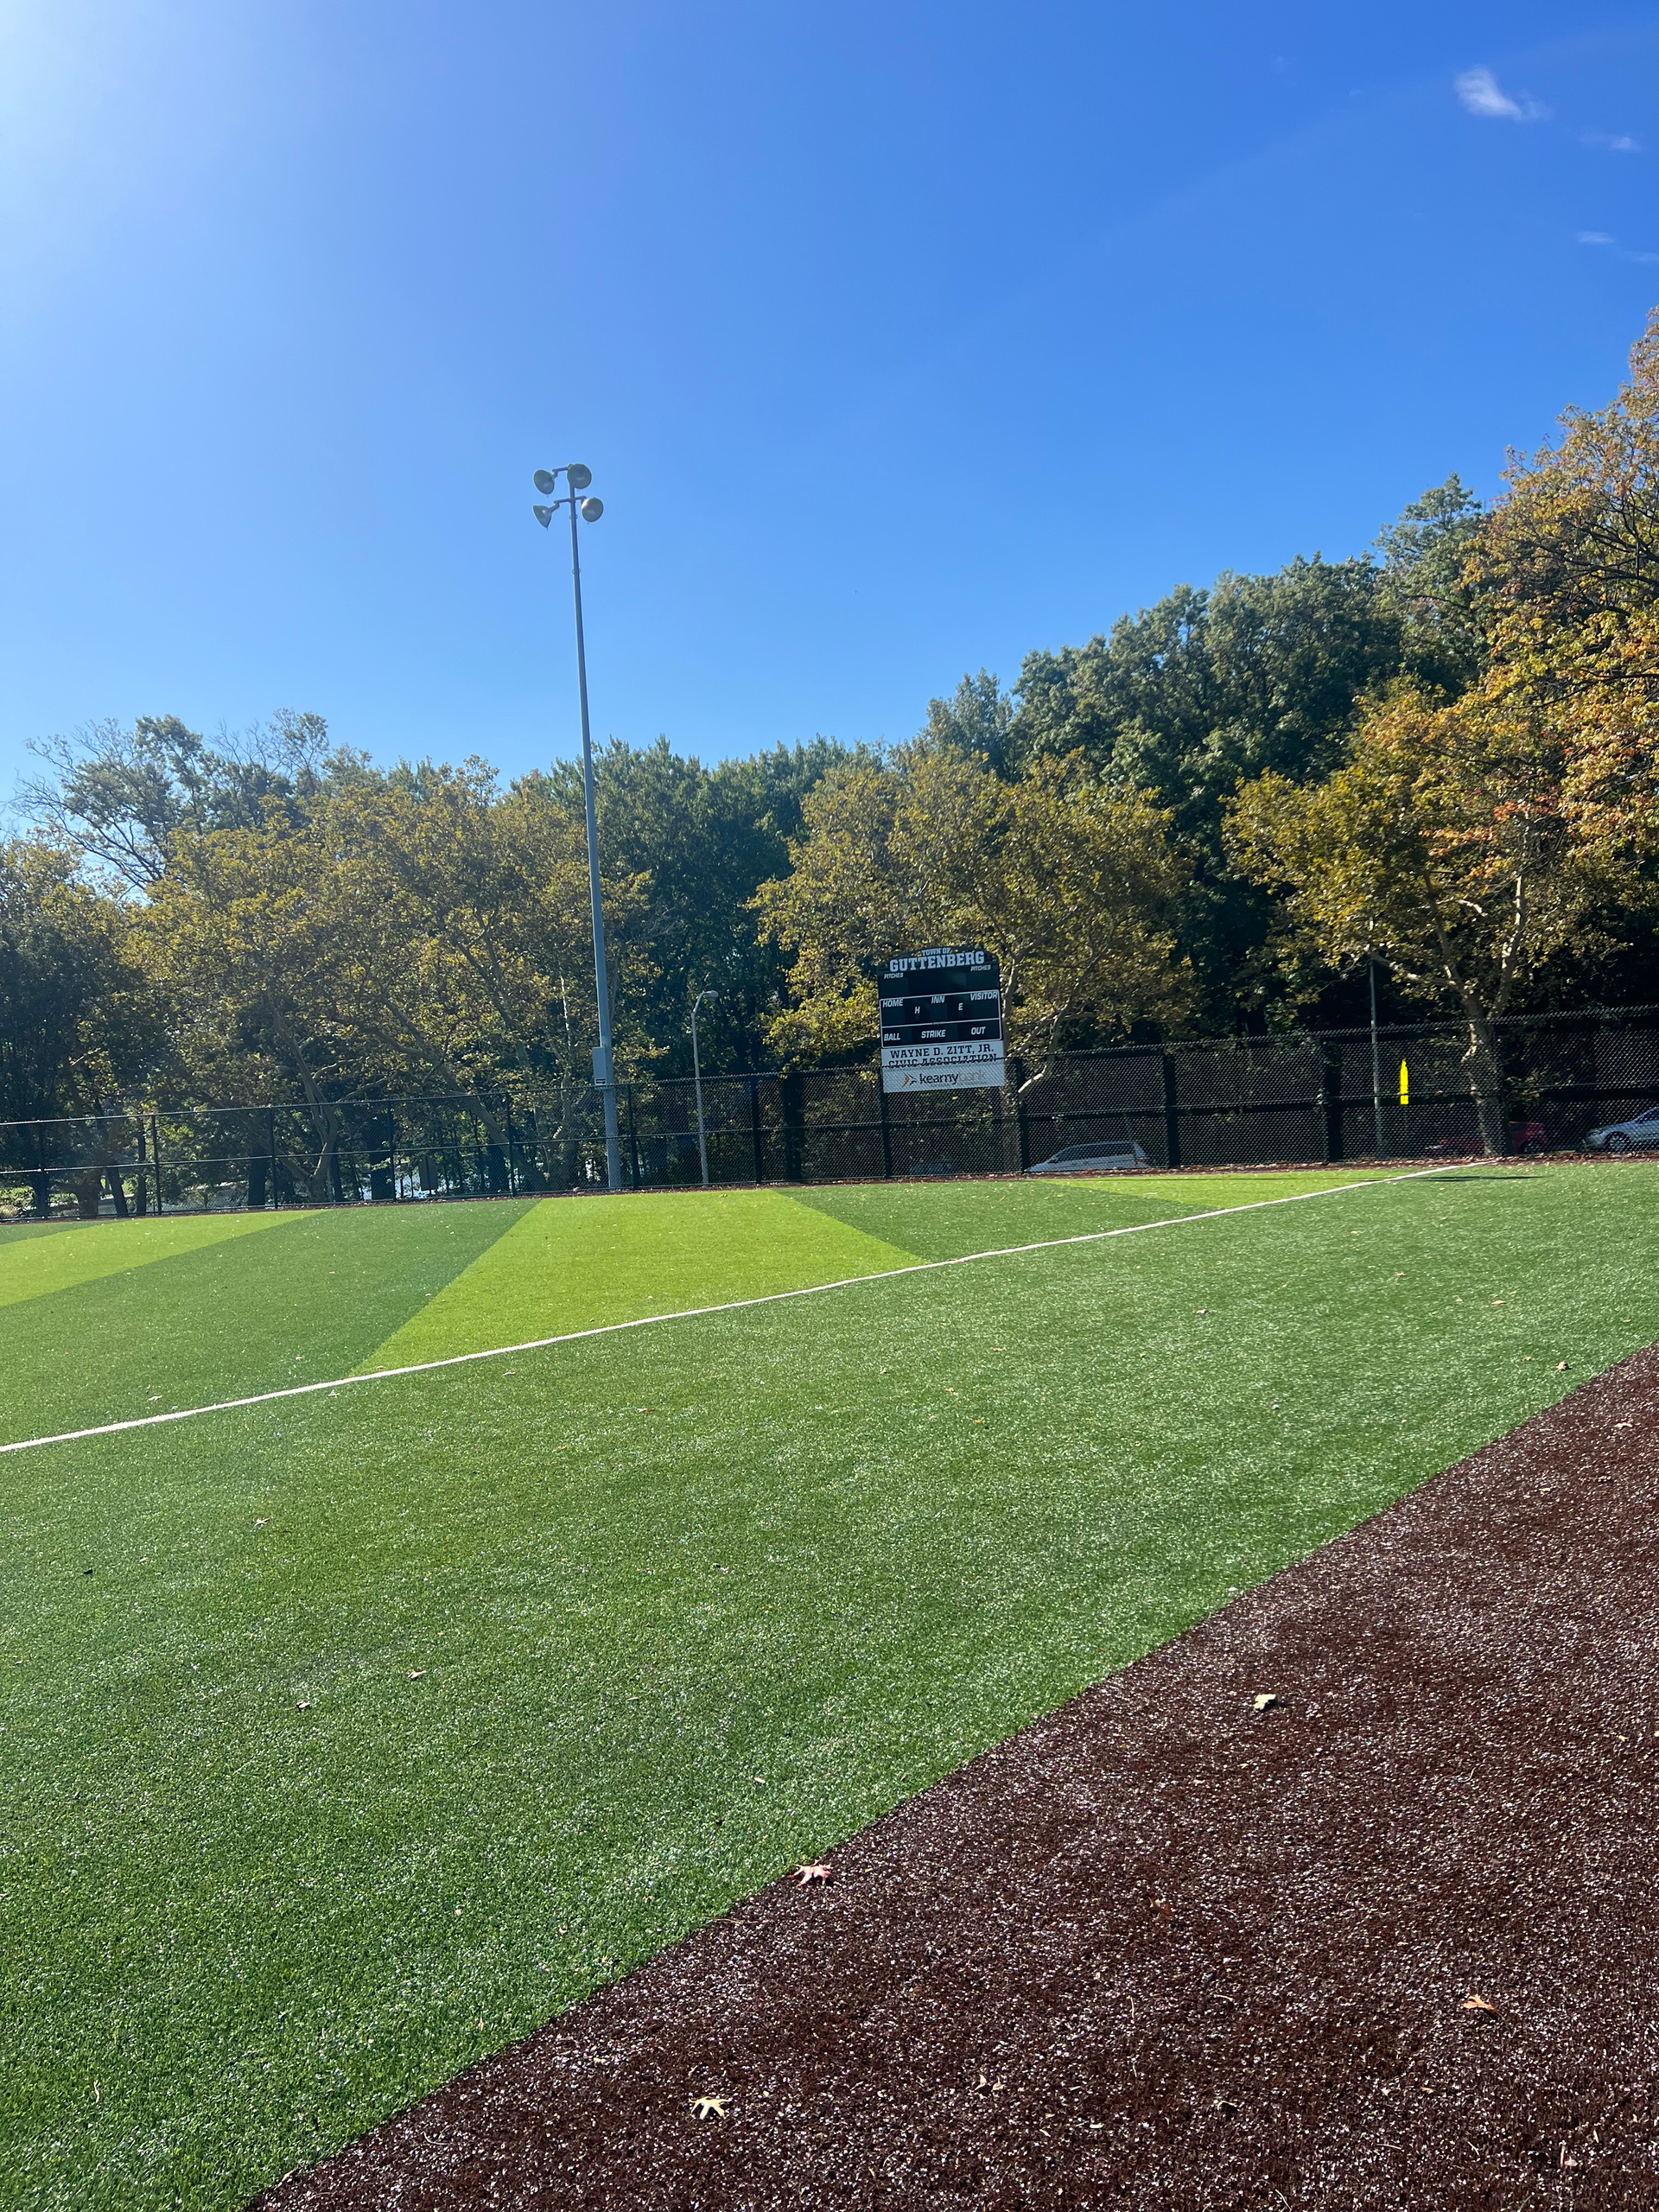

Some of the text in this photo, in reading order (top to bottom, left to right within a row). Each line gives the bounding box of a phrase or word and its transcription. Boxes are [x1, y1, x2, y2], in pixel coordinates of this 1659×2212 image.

[889, 950, 985, 972] GUTTENBERG
[931, 995, 945, 1004] INN
[969, 992, 998, 1001] VISITOR
[882, 999, 904, 1007] HOME
[958, 1002, 963, 1011] E
[914, 1006, 920, 1014] H
[921, 1029, 946, 1039] STRIKE
[970, 1027, 986, 1035] OUT
[884, 1033, 900, 1041] BALL
[890, 1048, 930, 1058] WAYNE
[947, 1046, 975, 1054] ZITT,
[978, 1044, 994, 1052] JR.
